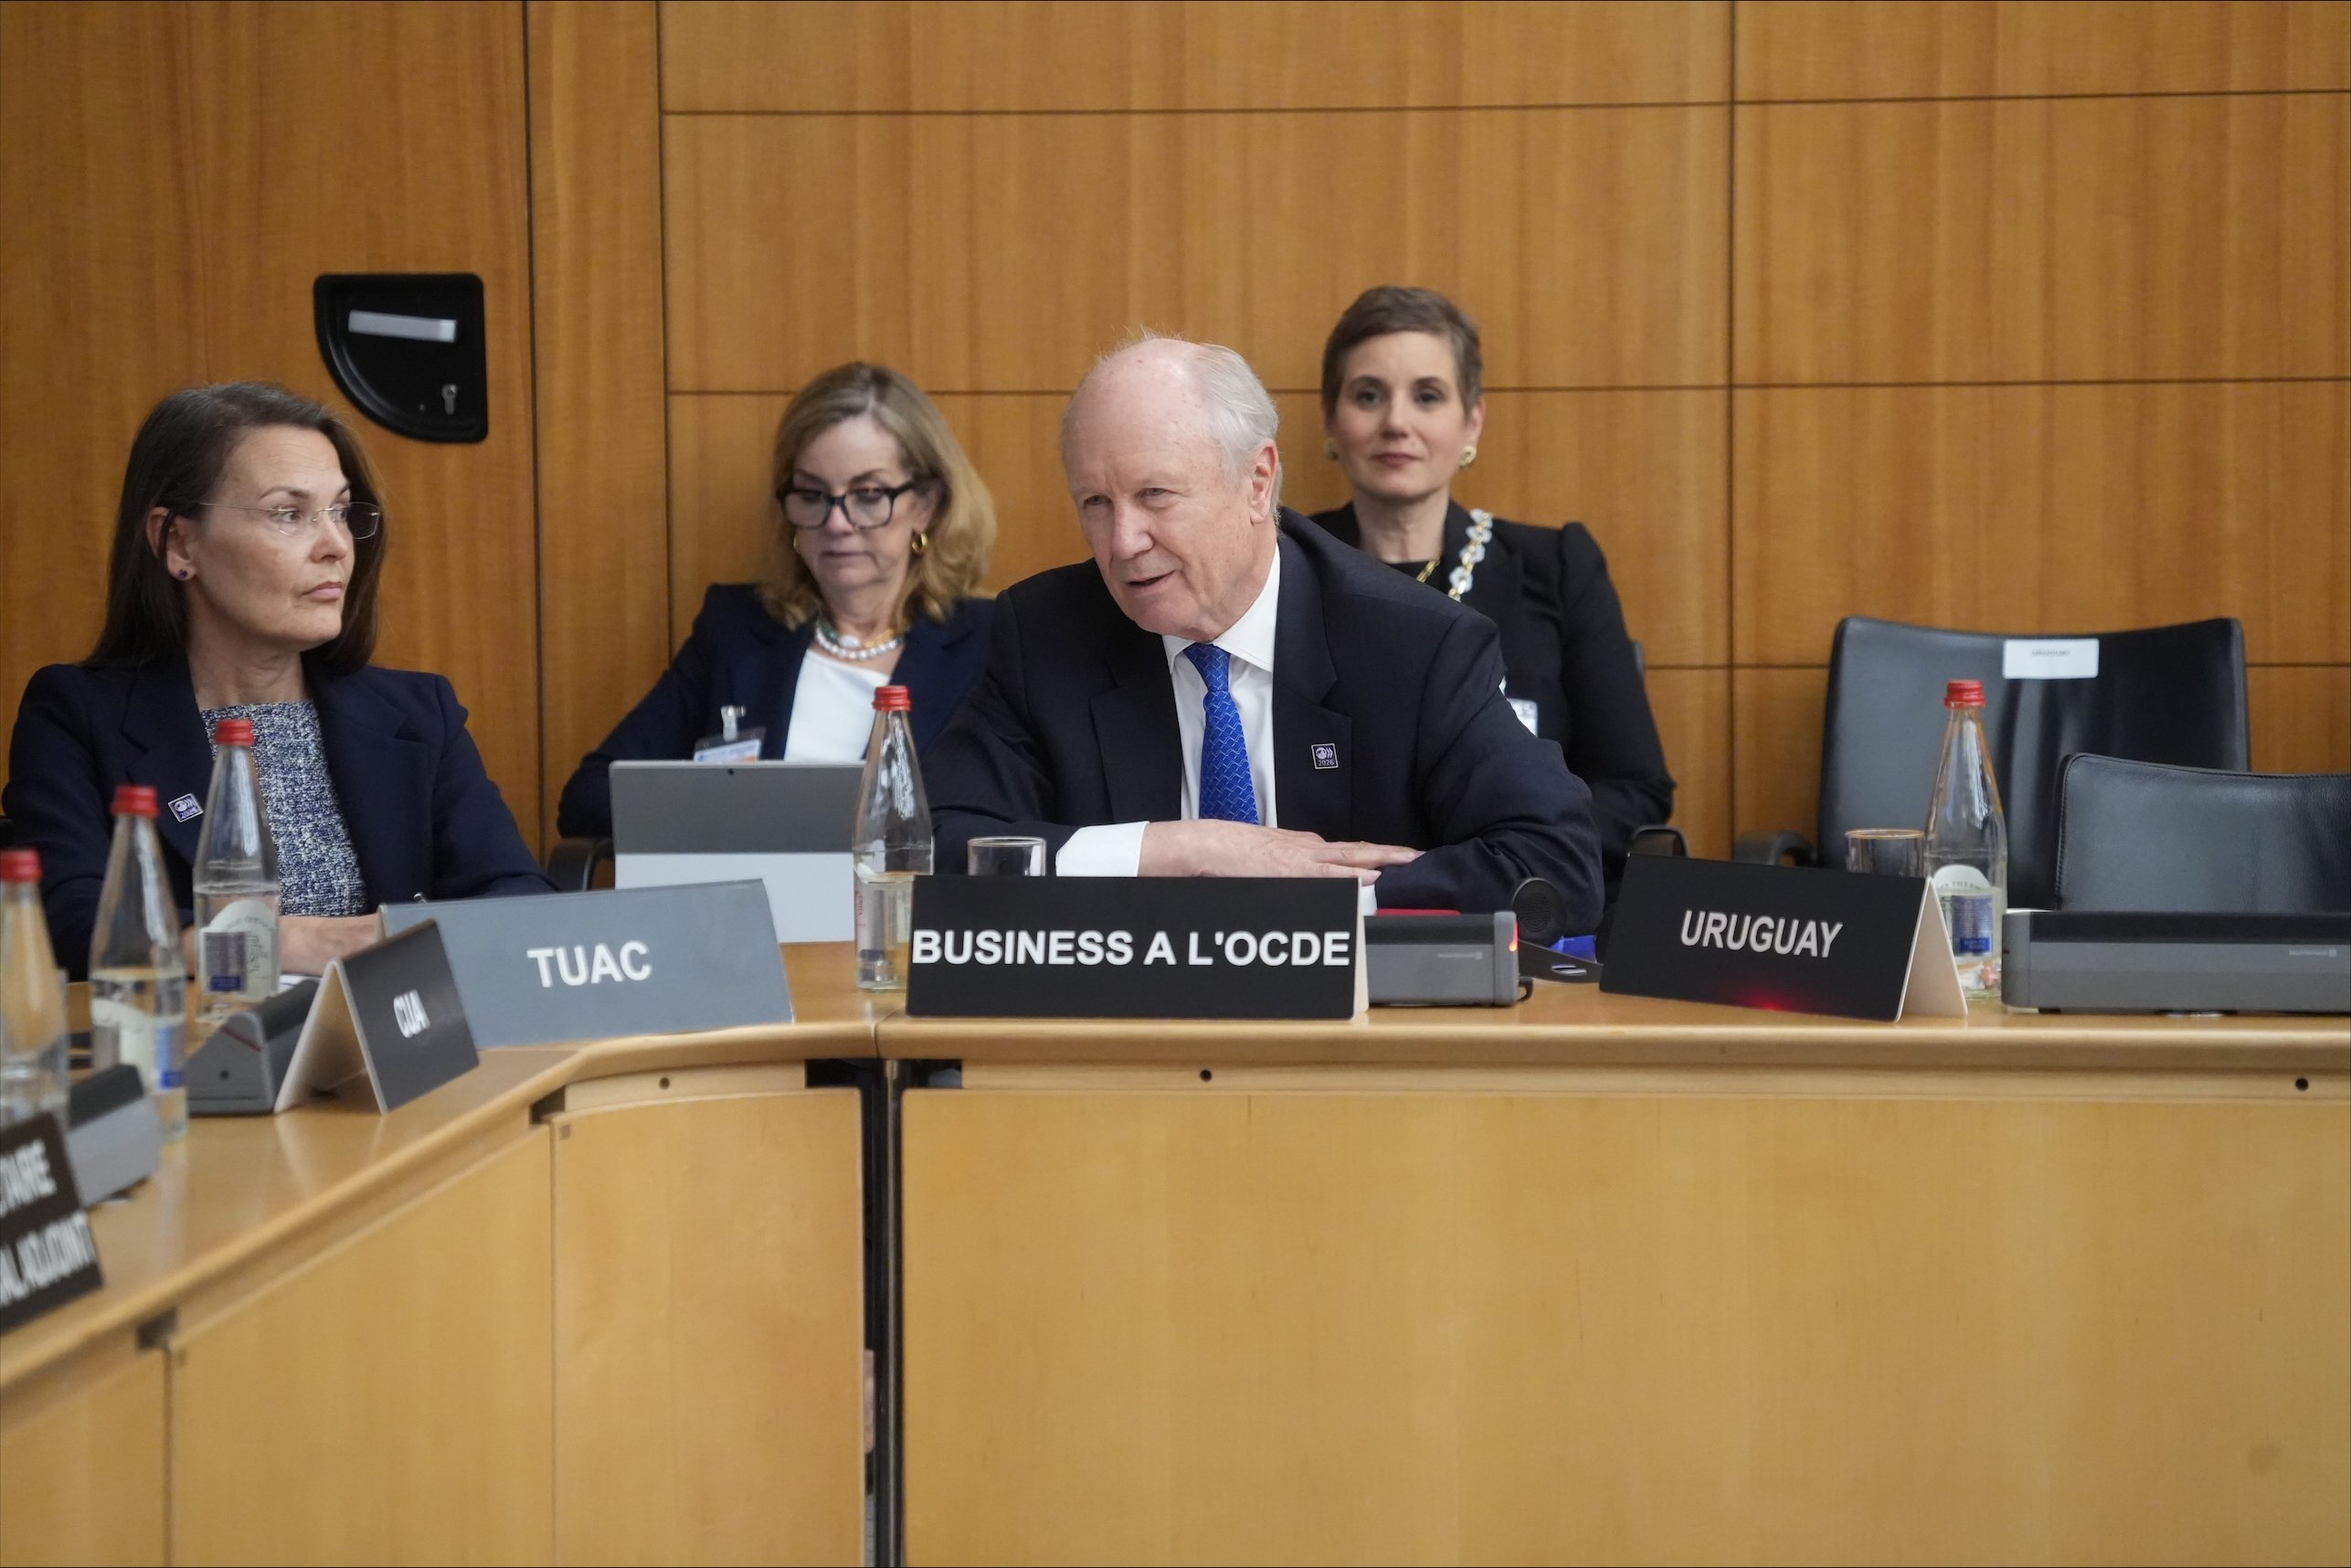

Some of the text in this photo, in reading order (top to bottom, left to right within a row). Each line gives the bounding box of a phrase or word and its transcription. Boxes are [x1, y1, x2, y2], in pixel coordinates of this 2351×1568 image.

[912, 928, 1351, 967] BUSINESS A L'OCDE
[1679, 908, 1844, 959] URUGUAY
[525, 939, 654, 989] TUAC
